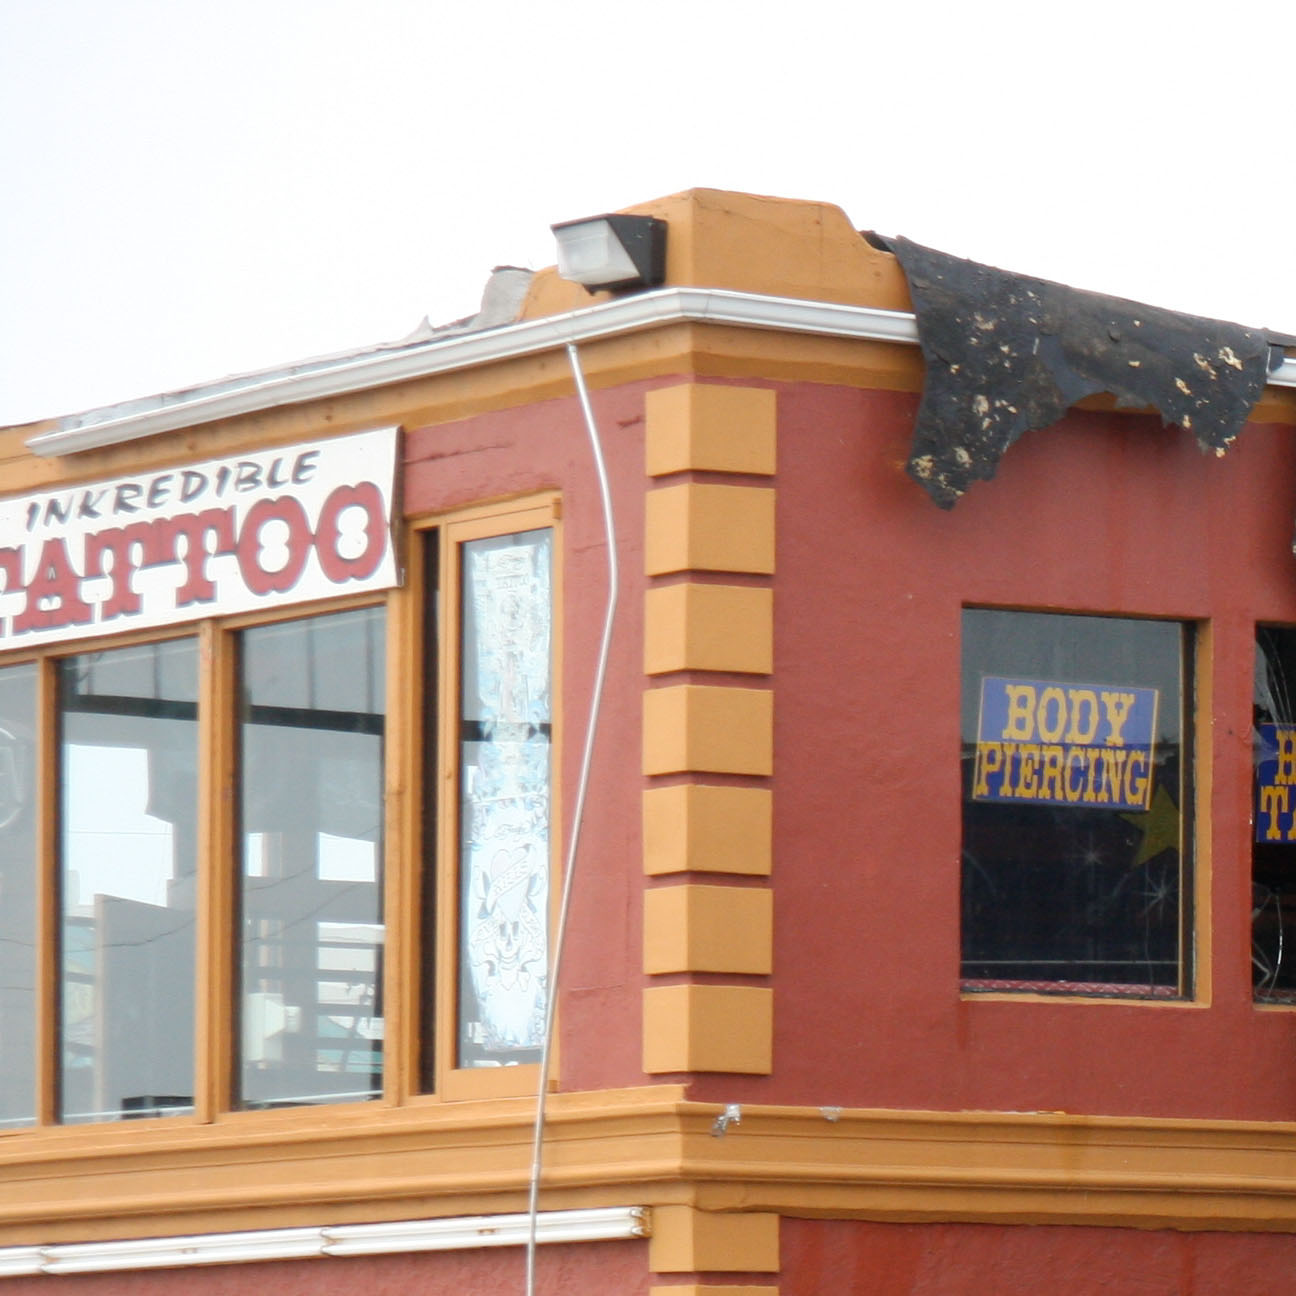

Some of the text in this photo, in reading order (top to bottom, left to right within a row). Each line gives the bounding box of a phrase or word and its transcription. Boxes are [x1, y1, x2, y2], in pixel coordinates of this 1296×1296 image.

[26, 449, 321, 532] INKREDIBLE
[1002, 684, 1136, 745] BODY
[976, 742, 1150, 806] PIERCING
